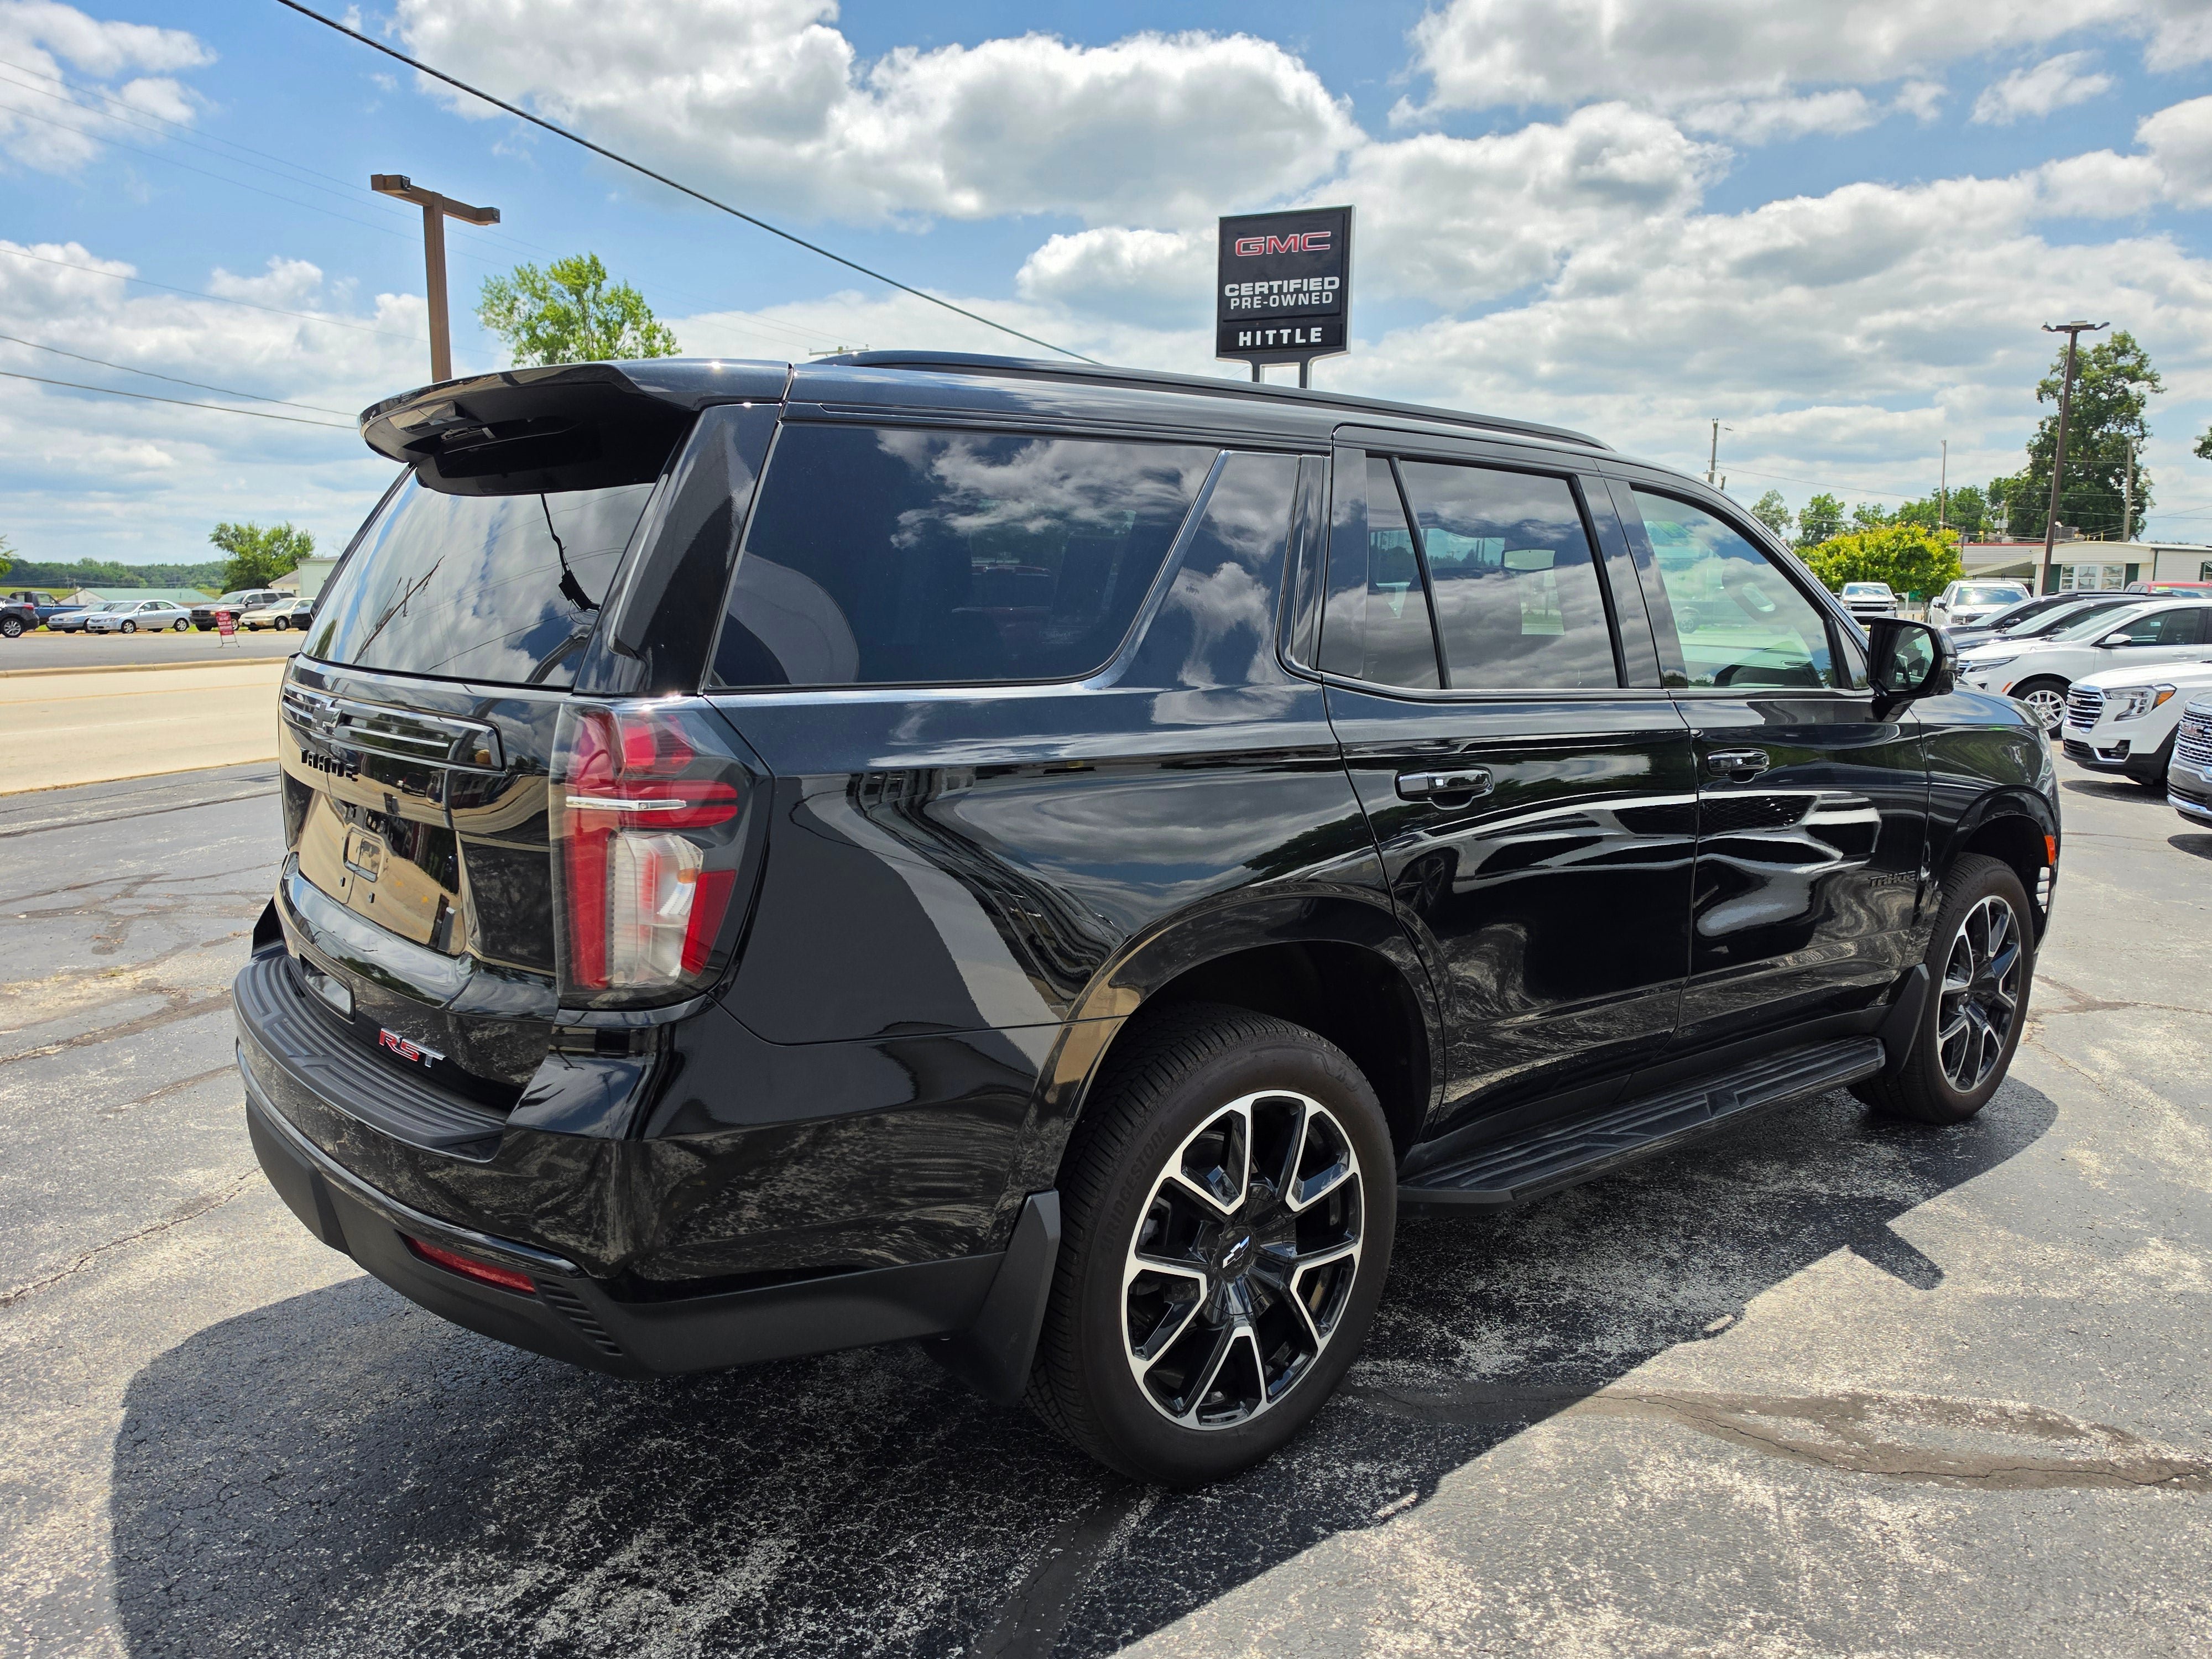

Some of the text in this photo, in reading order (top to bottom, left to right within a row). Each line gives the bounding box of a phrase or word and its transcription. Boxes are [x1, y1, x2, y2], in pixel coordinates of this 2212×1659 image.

[1235, 231, 1331, 256] GMC
[1224, 276, 1340, 296] CERTIFIED
[1230, 291, 1333, 310] PRE-OWNED
[1239, 327, 1322, 346] HITTLE
[300, 747, 359, 782] TAHOE
[1868, 870, 1916, 887] TAHOE
[378, 1027, 447, 1068] RST
[1102, 1121, 1171, 1254] BRIDGESTONE
